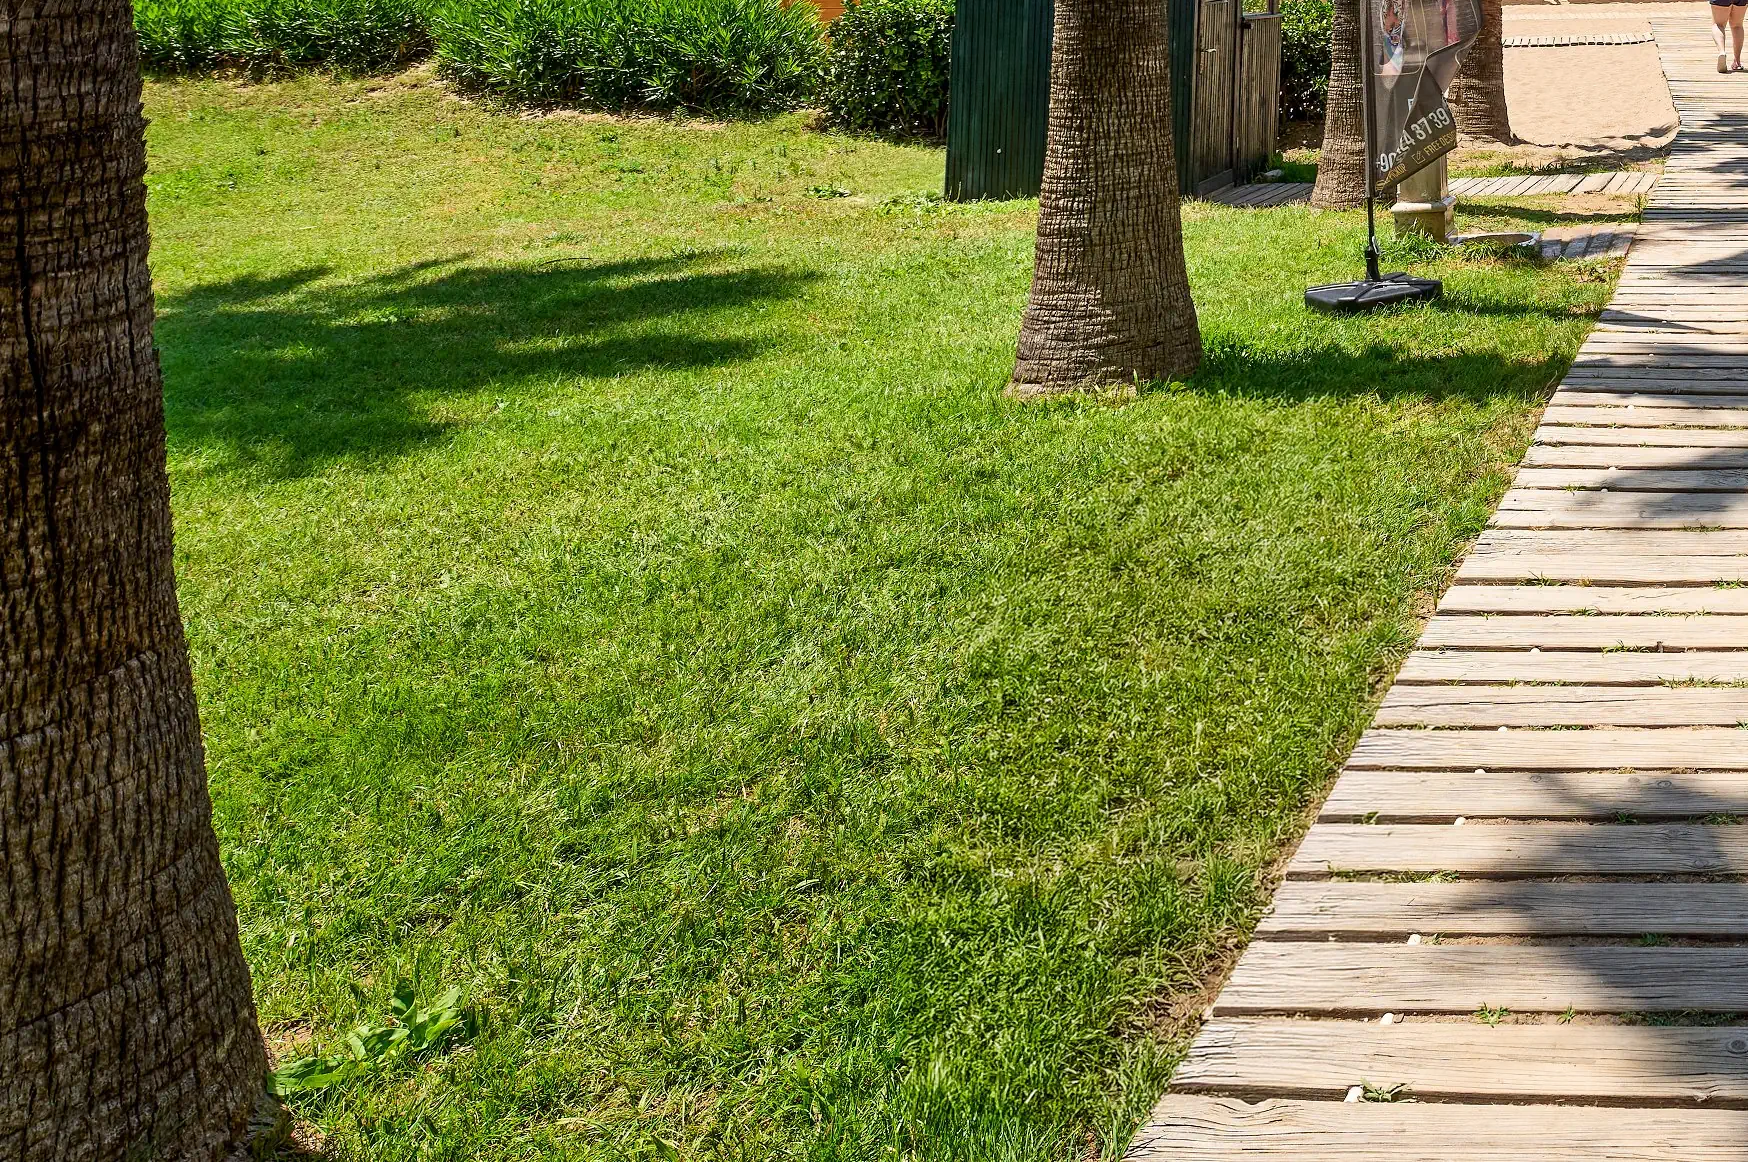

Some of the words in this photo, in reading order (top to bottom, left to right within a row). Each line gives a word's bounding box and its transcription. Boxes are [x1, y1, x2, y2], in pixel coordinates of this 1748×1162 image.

[1410, 117, 1432, 140] 37
[1429, 107, 1450, 129] 39
[1424, 139, 1442, 156] FREE
